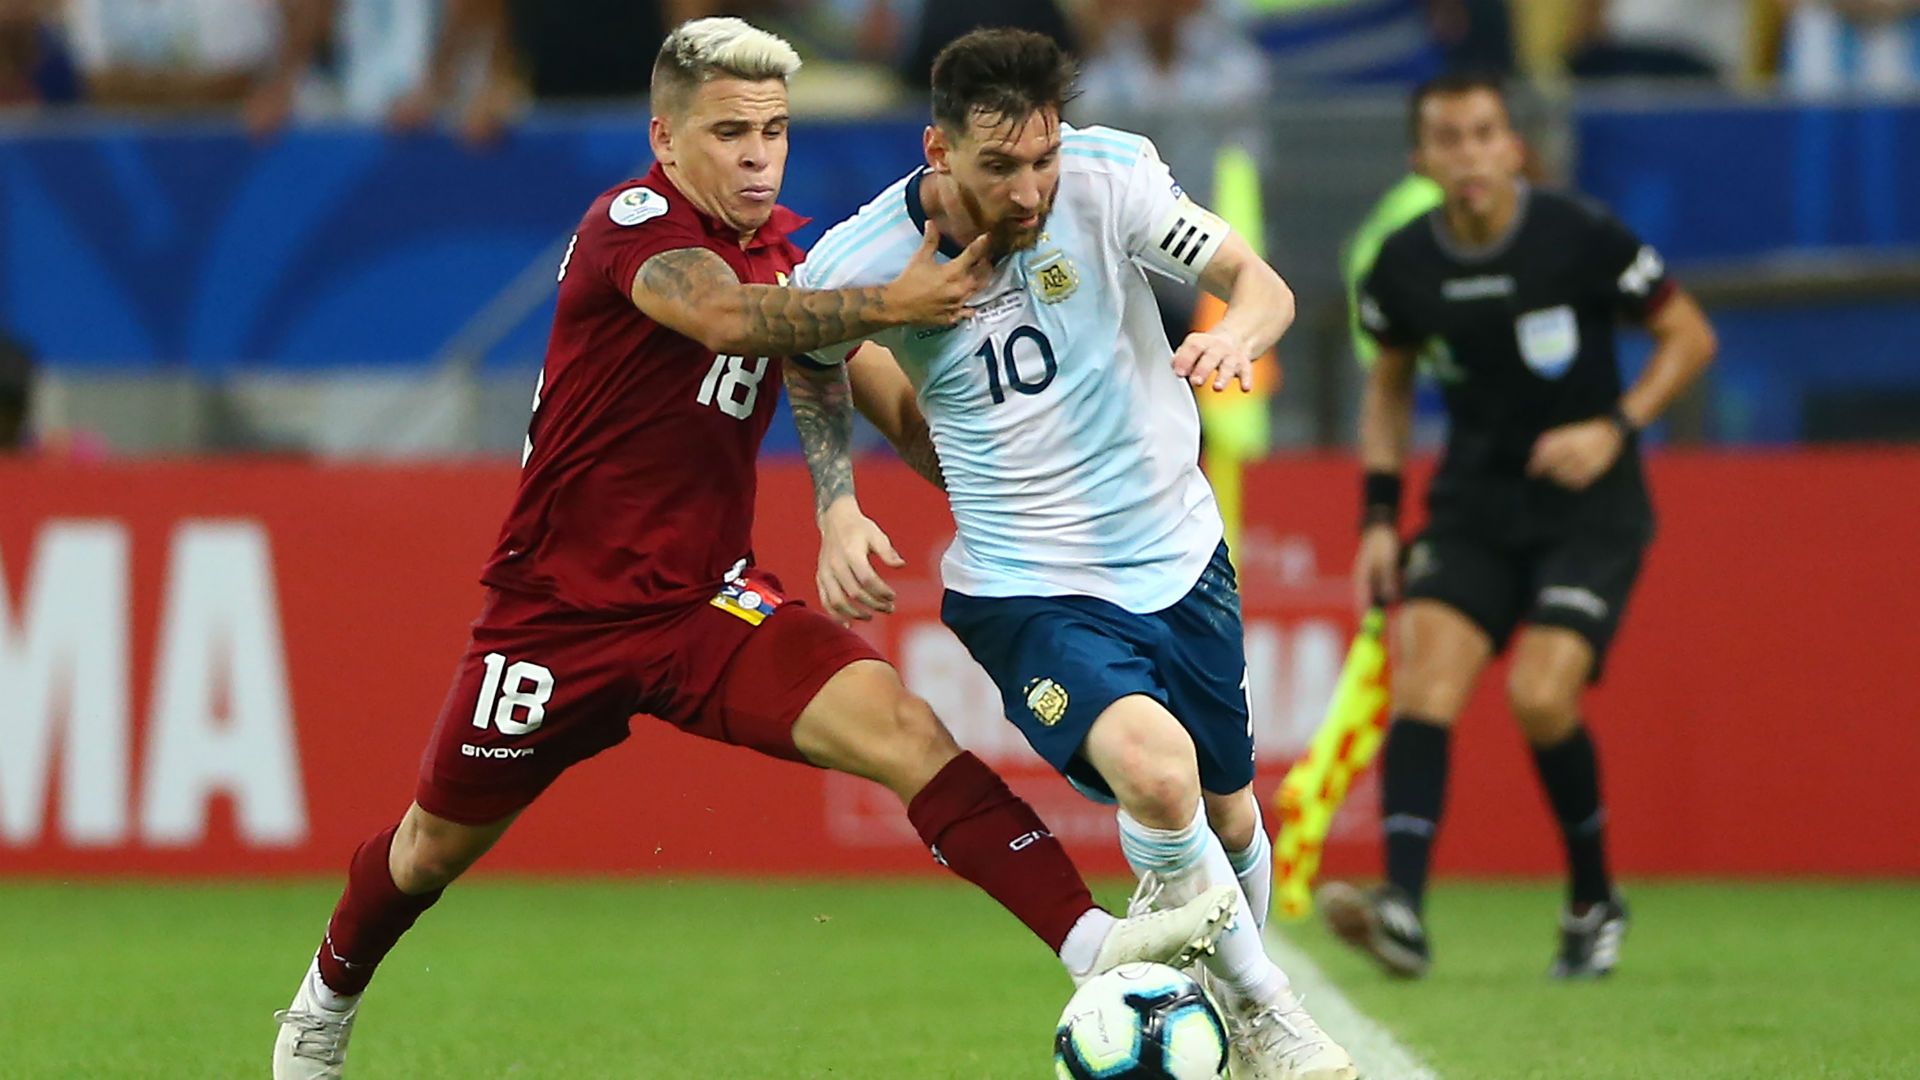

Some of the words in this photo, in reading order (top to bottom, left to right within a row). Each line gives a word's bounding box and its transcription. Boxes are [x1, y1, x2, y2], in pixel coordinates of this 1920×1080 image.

[696, 355, 769, 420] 18
[974, 325, 1058, 404] 10
[472, 652, 555, 735] 18
